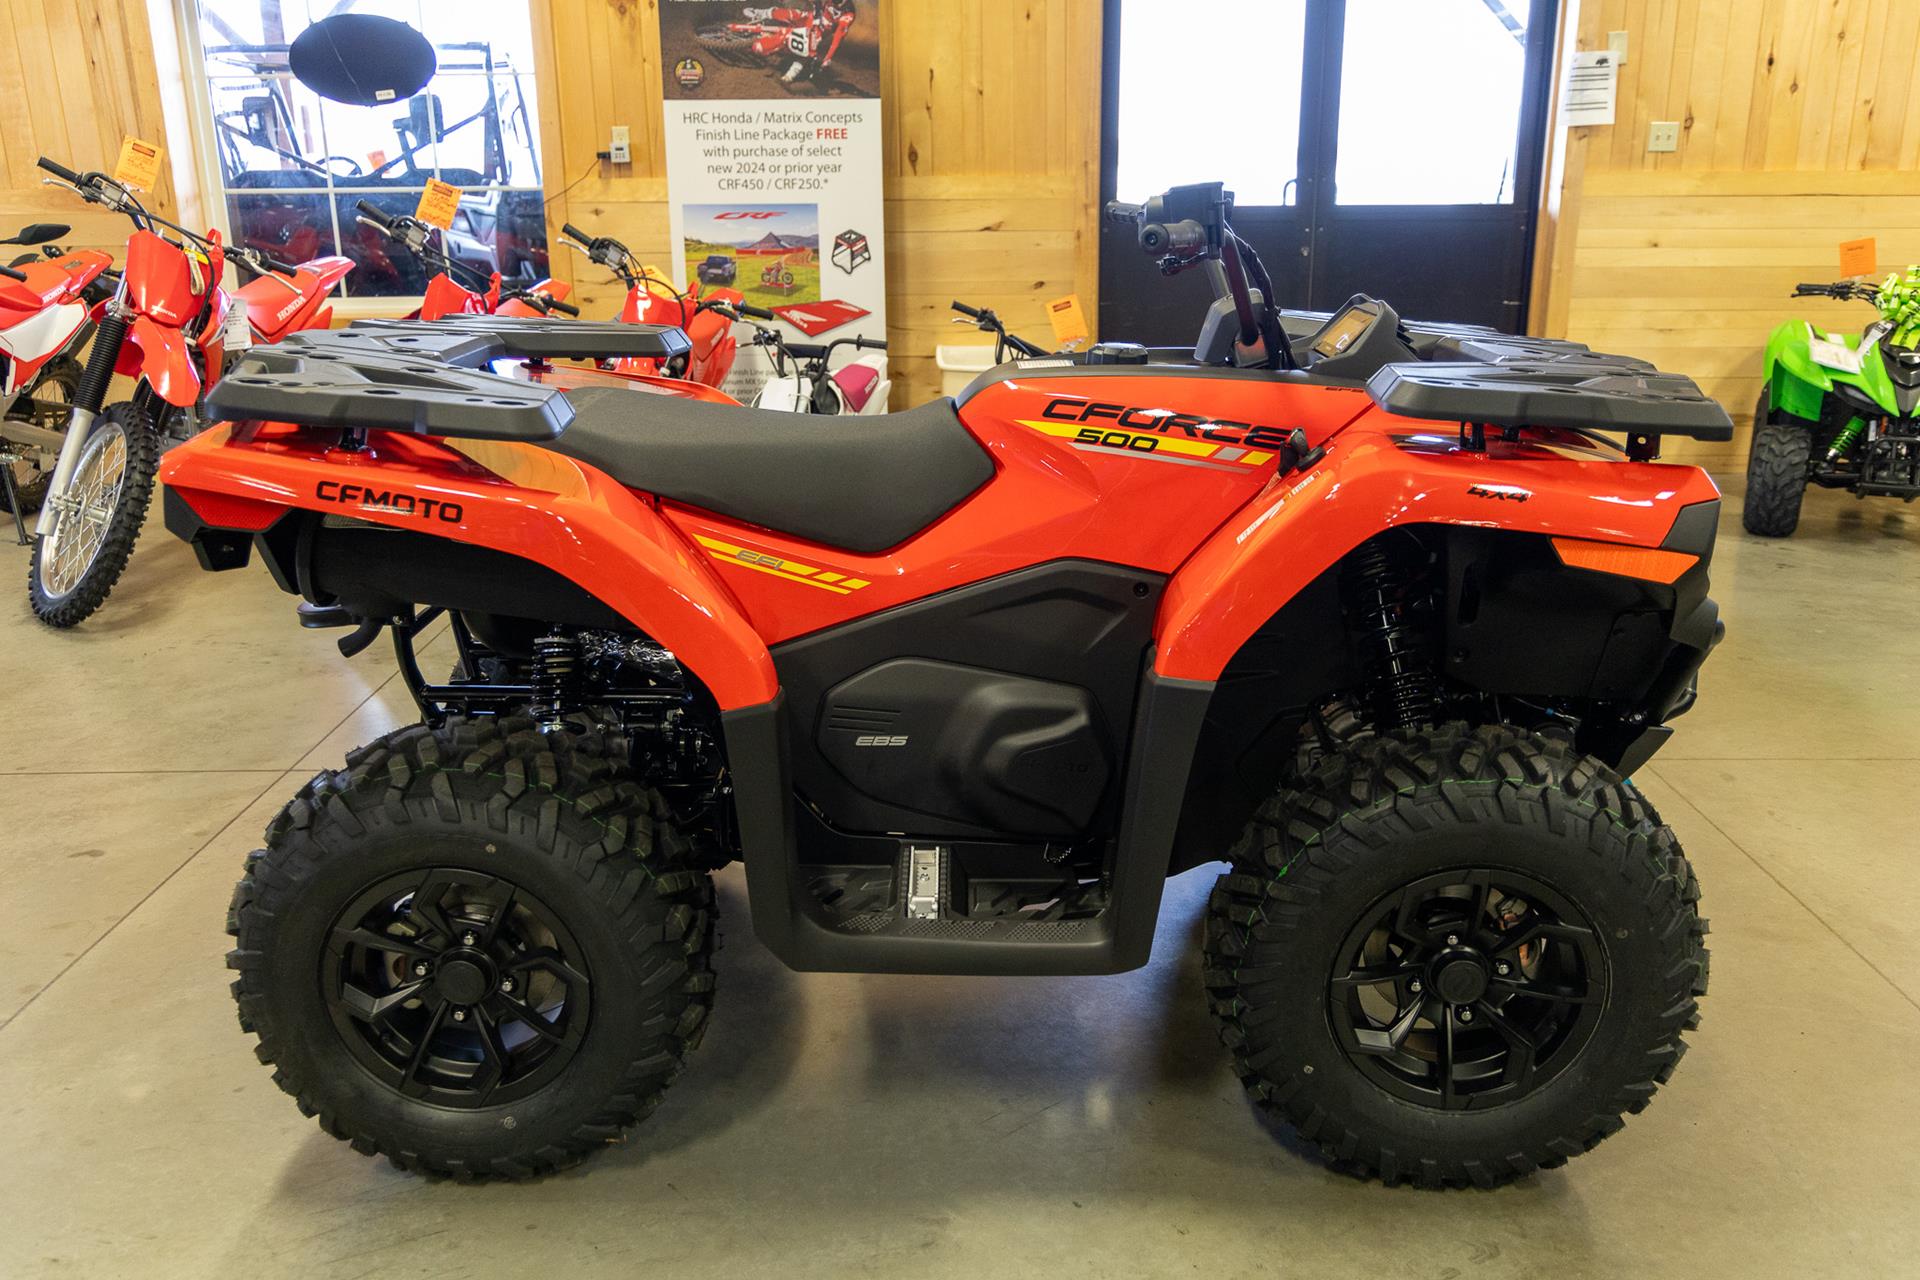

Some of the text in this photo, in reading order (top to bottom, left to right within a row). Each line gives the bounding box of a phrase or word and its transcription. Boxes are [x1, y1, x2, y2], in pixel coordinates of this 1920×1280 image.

[683, 111, 863, 128] HRC Honda / Matrix Concepts
[695, 128, 848, 143] Finish Line Package FREE
[703, 145, 842, 160] with purchase of select
[707, 162, 842, 177] new 2024 or prior year
[718, 178, 764, 190] CRF450
[713, 212, 788, 220] CRF
[277, 296, 306, 321] HONDA
[1042, 398, 1292, 450] CFORCE
[1074, 428, 1159, 453] 500
[316, 480, 464, 524] CFMOTO
[735, 549, 785, 570] EFI
[855, 735, 909, 747] EBS
